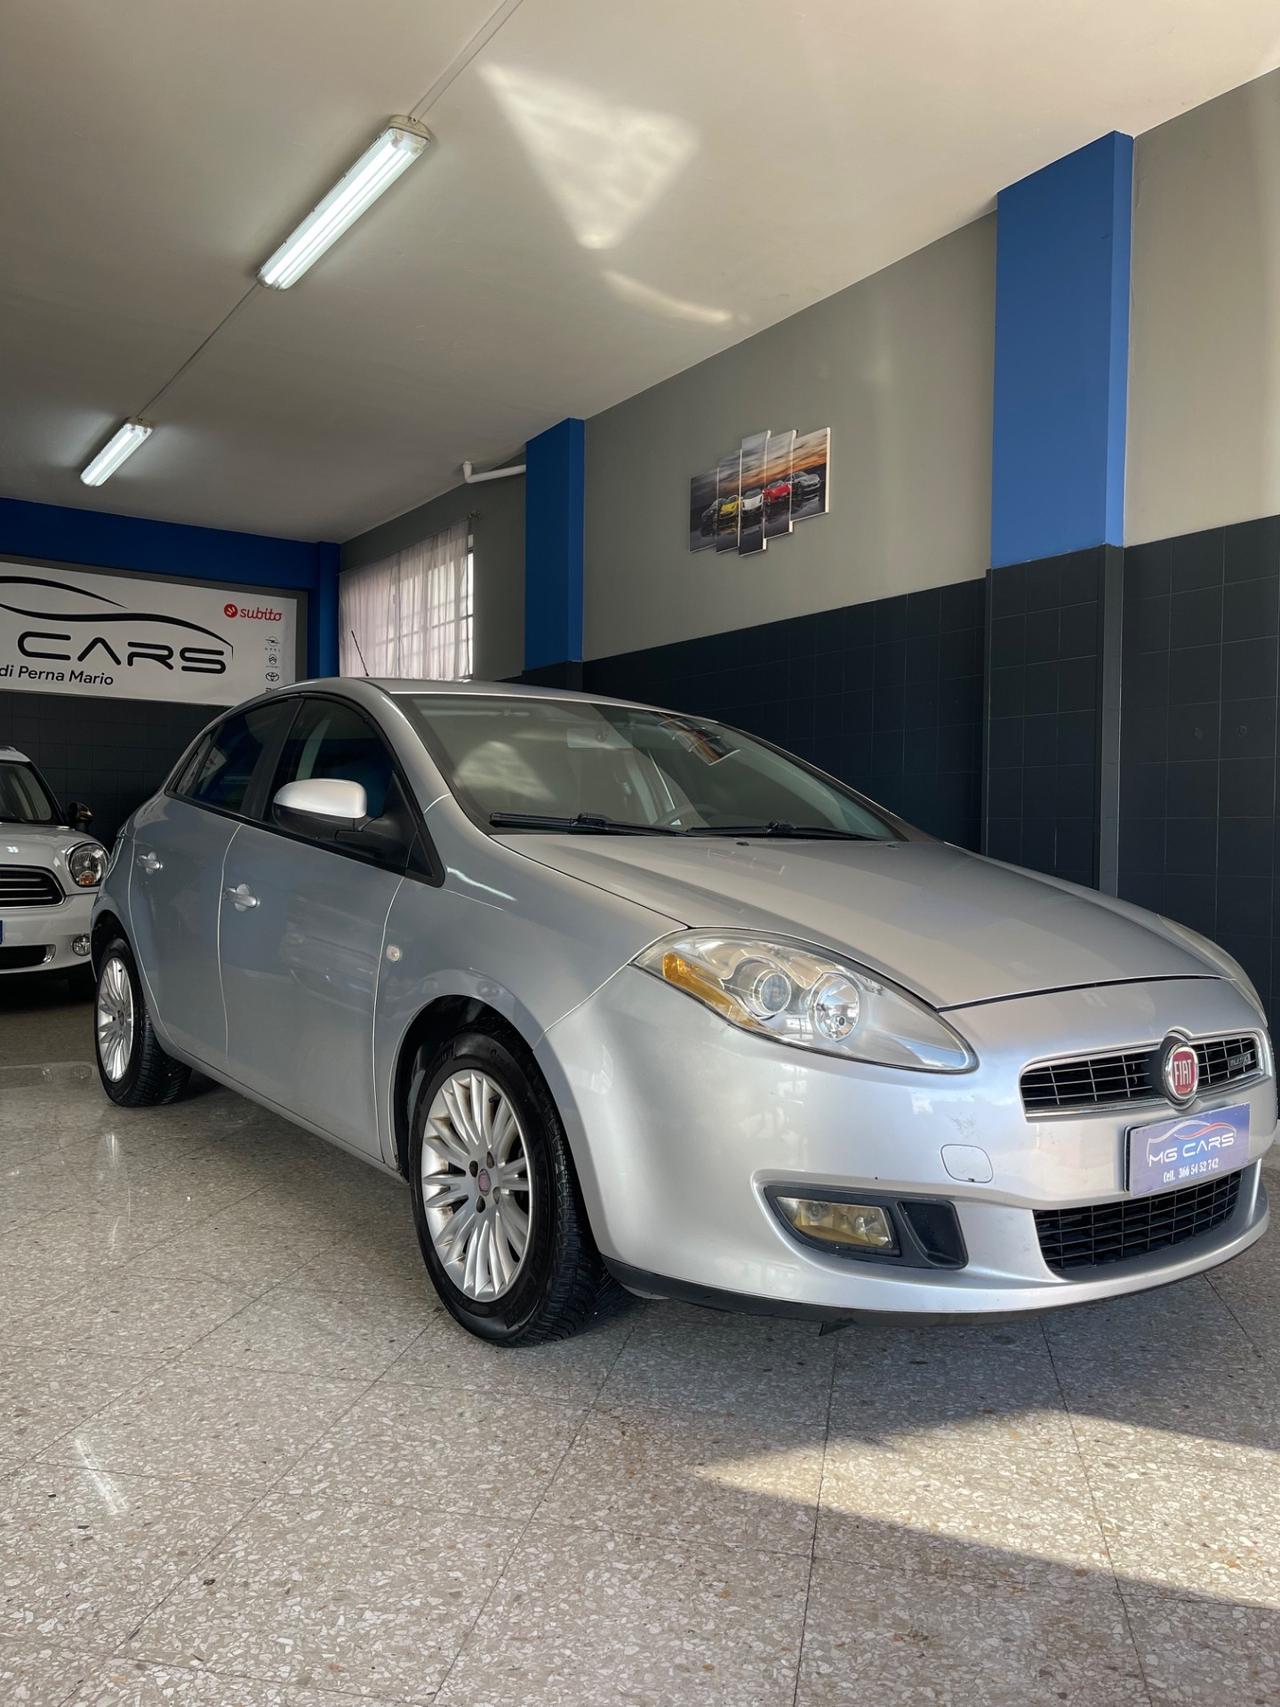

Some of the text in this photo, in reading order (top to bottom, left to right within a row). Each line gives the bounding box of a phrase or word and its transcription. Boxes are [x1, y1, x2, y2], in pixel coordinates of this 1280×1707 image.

[240, 607, 283, 622] subito
[17, 631, 226, 674] CARS
[0, 664, 114, 686] di Perna Mario
[1173, 1059, 1192, 1086] FIAT
[1149, 1132, 1234, 1167] MG CARS
